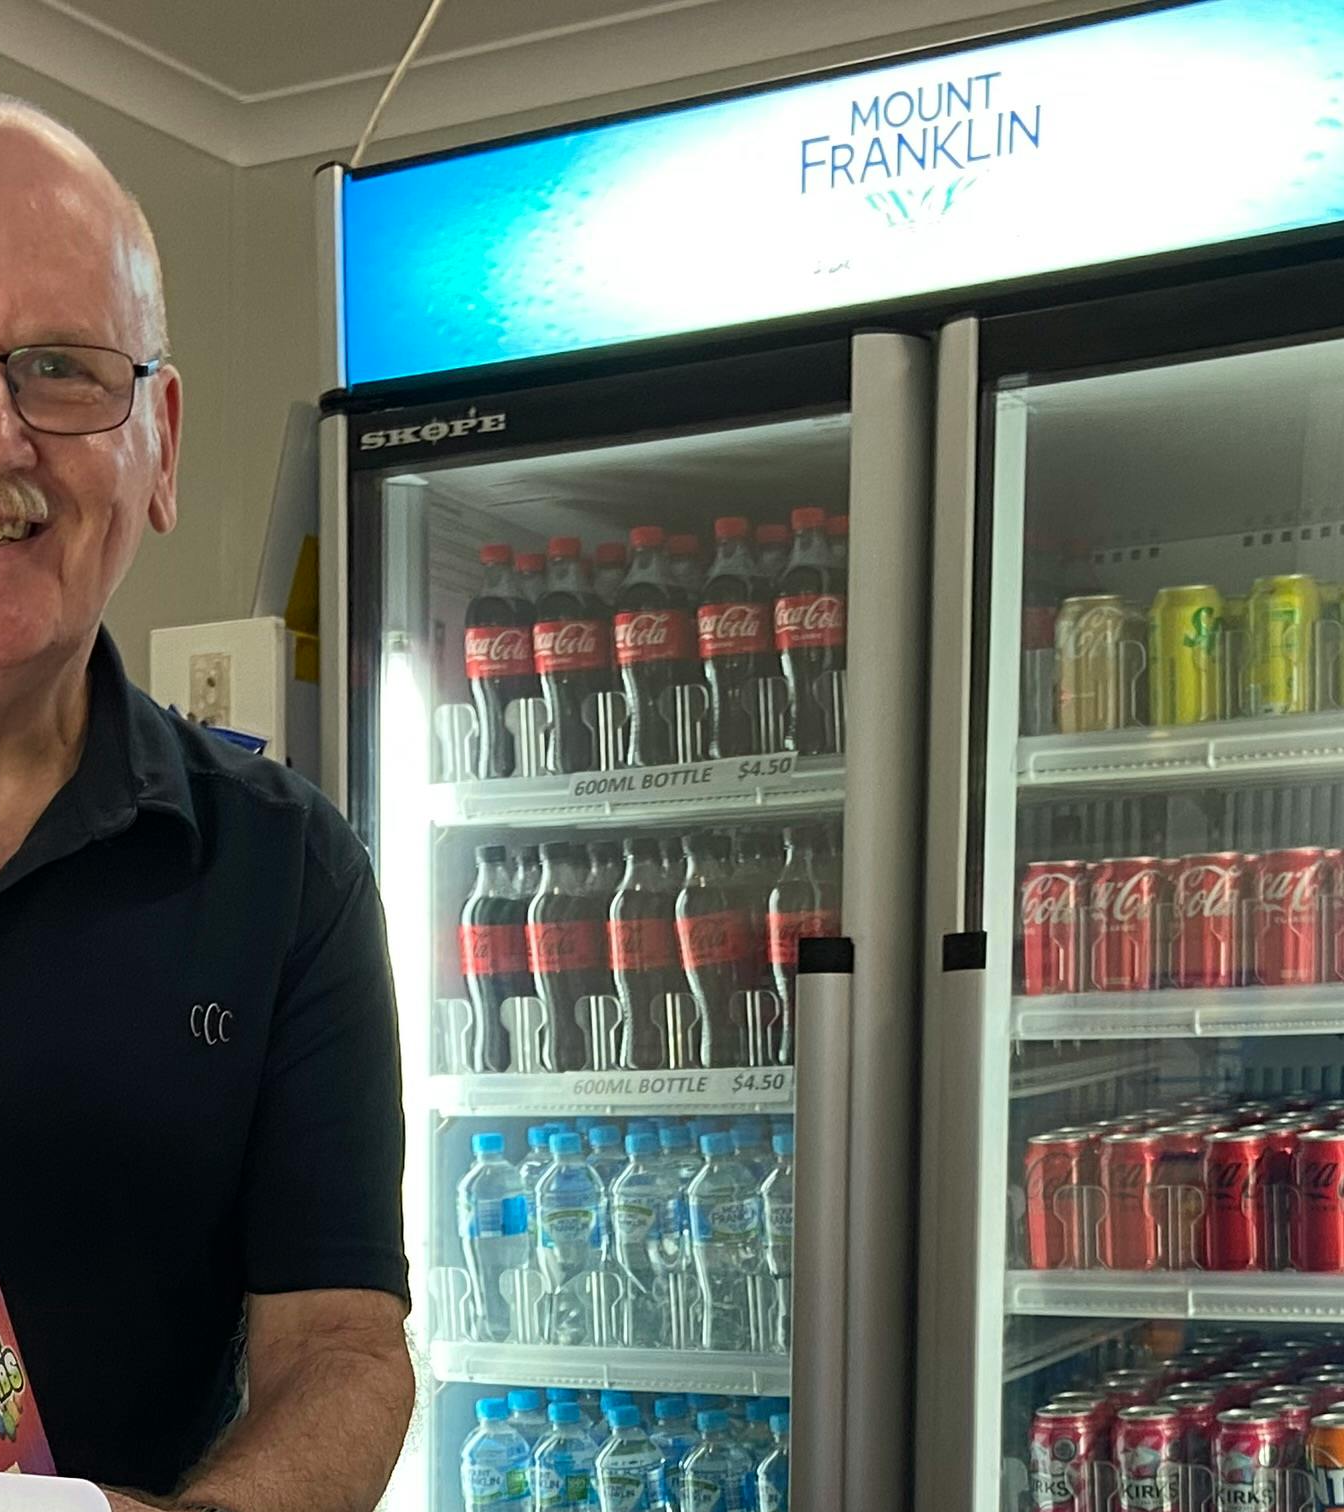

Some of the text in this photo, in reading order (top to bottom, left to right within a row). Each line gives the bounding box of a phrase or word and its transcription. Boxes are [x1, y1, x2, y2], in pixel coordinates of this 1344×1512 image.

[850, 72, 1002, 136] MOUNT
[799, 105, 1043, 194] FRANKLIN
[575, 757, 792, 796] 600ML BOTTLE $4.50
[573, 1073, 785, 1095] 600ML BOTTLE $4.50
[1120, 1480, 1179, 1500] KIRKS
[1215, 1487, 1274, 1505] KIRKS
